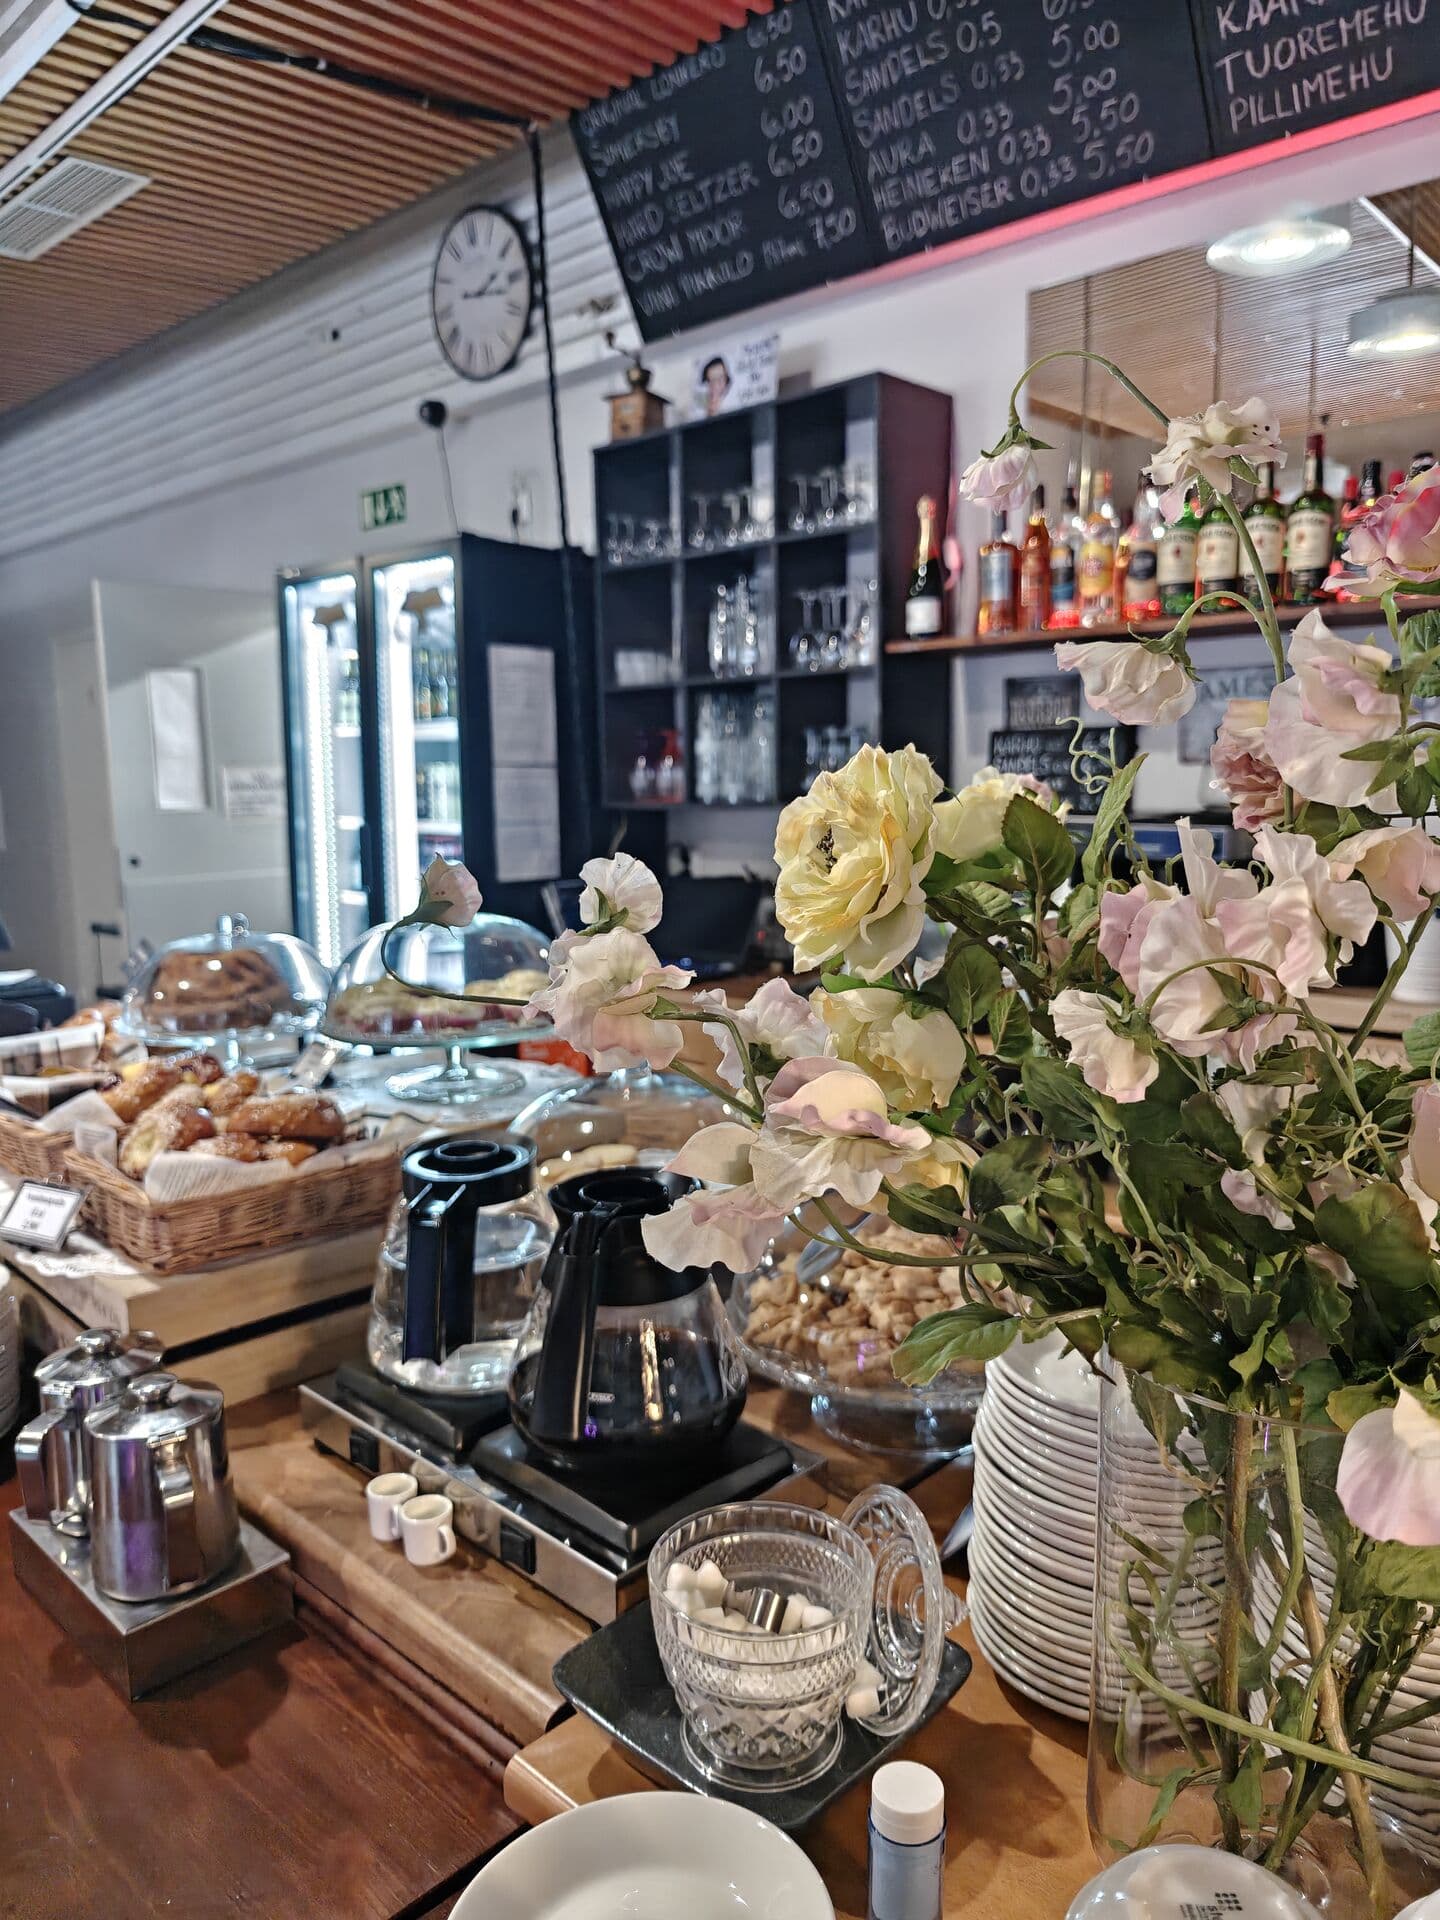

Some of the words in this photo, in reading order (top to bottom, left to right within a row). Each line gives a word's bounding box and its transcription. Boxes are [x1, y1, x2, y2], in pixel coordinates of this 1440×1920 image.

[837, 0, 918, 64] KARHU
[846, 30, 949, 106] SANDELS
[1214, 0, 1428, 94] TUOREMEHU
[852, 72, 961, 148] SANDELS
[1228, 46, 1393, 135] PILLIMEHU
[867, 131, 936, 184] AURA
[880, 175, 1015, 250] BUDWEISER
